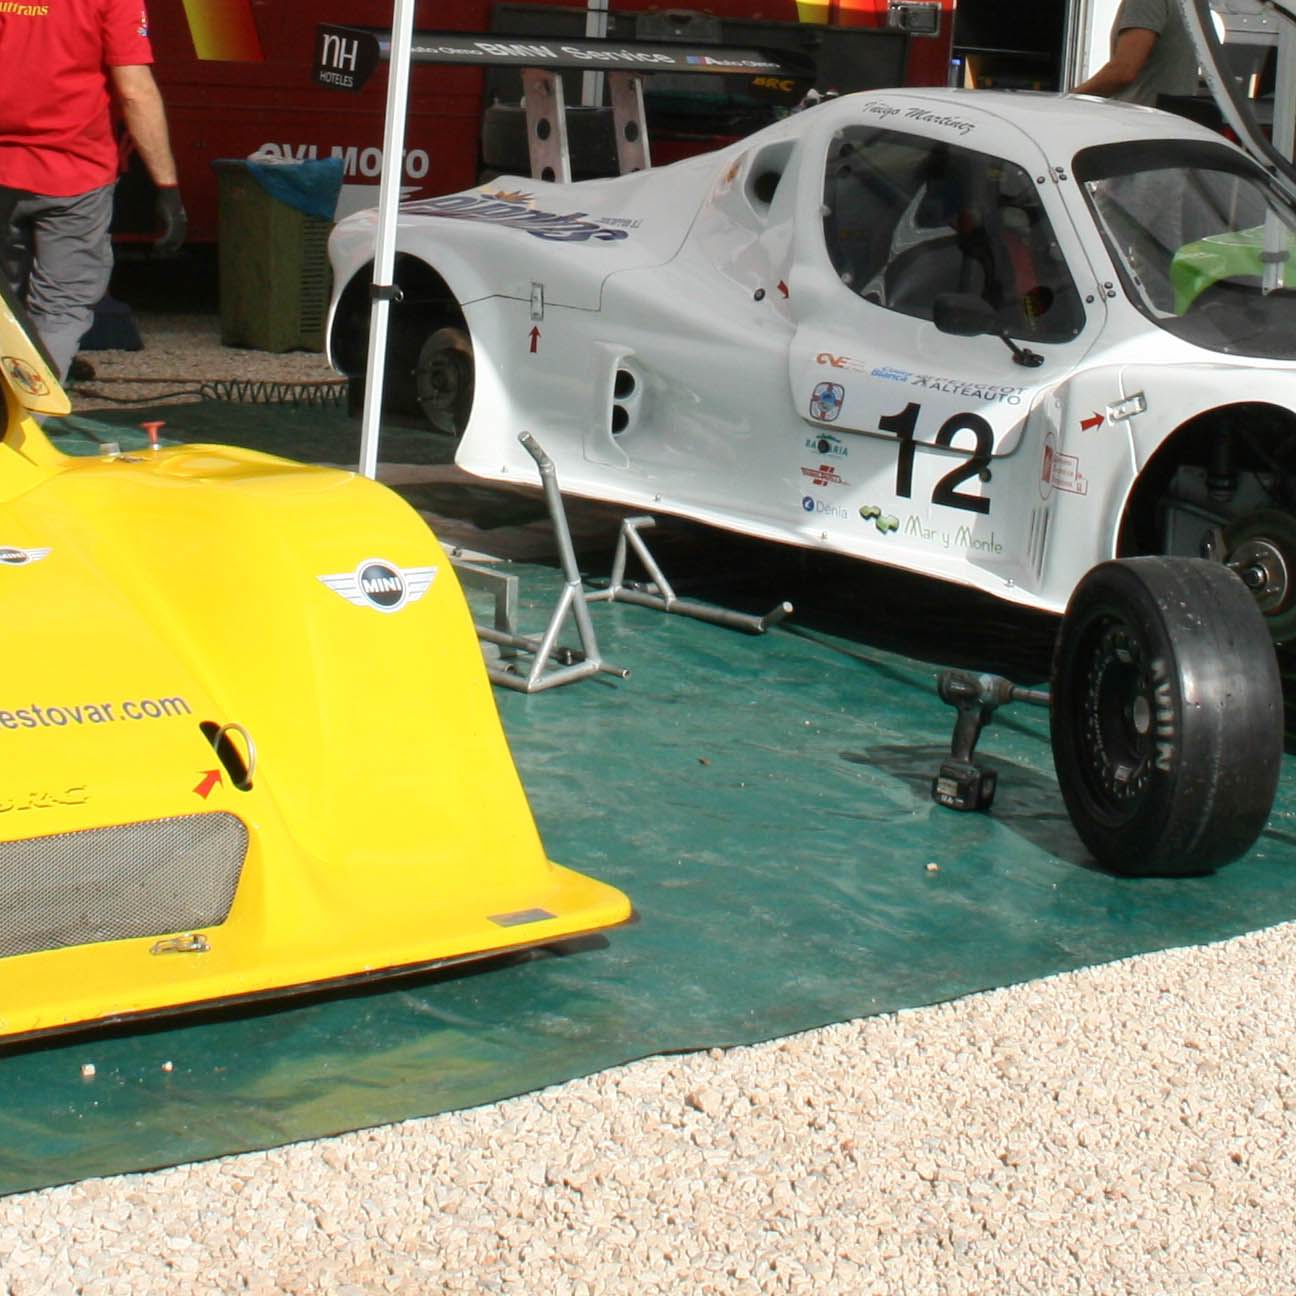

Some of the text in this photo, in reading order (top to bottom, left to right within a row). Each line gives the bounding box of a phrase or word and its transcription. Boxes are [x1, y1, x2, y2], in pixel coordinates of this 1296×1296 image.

[321, 34, 358, 71] nH
[474, 42, 558, 58] BMW
[560, 45, 676, 64] Service
[319, 70, 354, 87] HOTELES
[330, 145, 430, 179] MOO
[877, 401, 995, 515] 12
[362, 576, 403, 593] MINI
